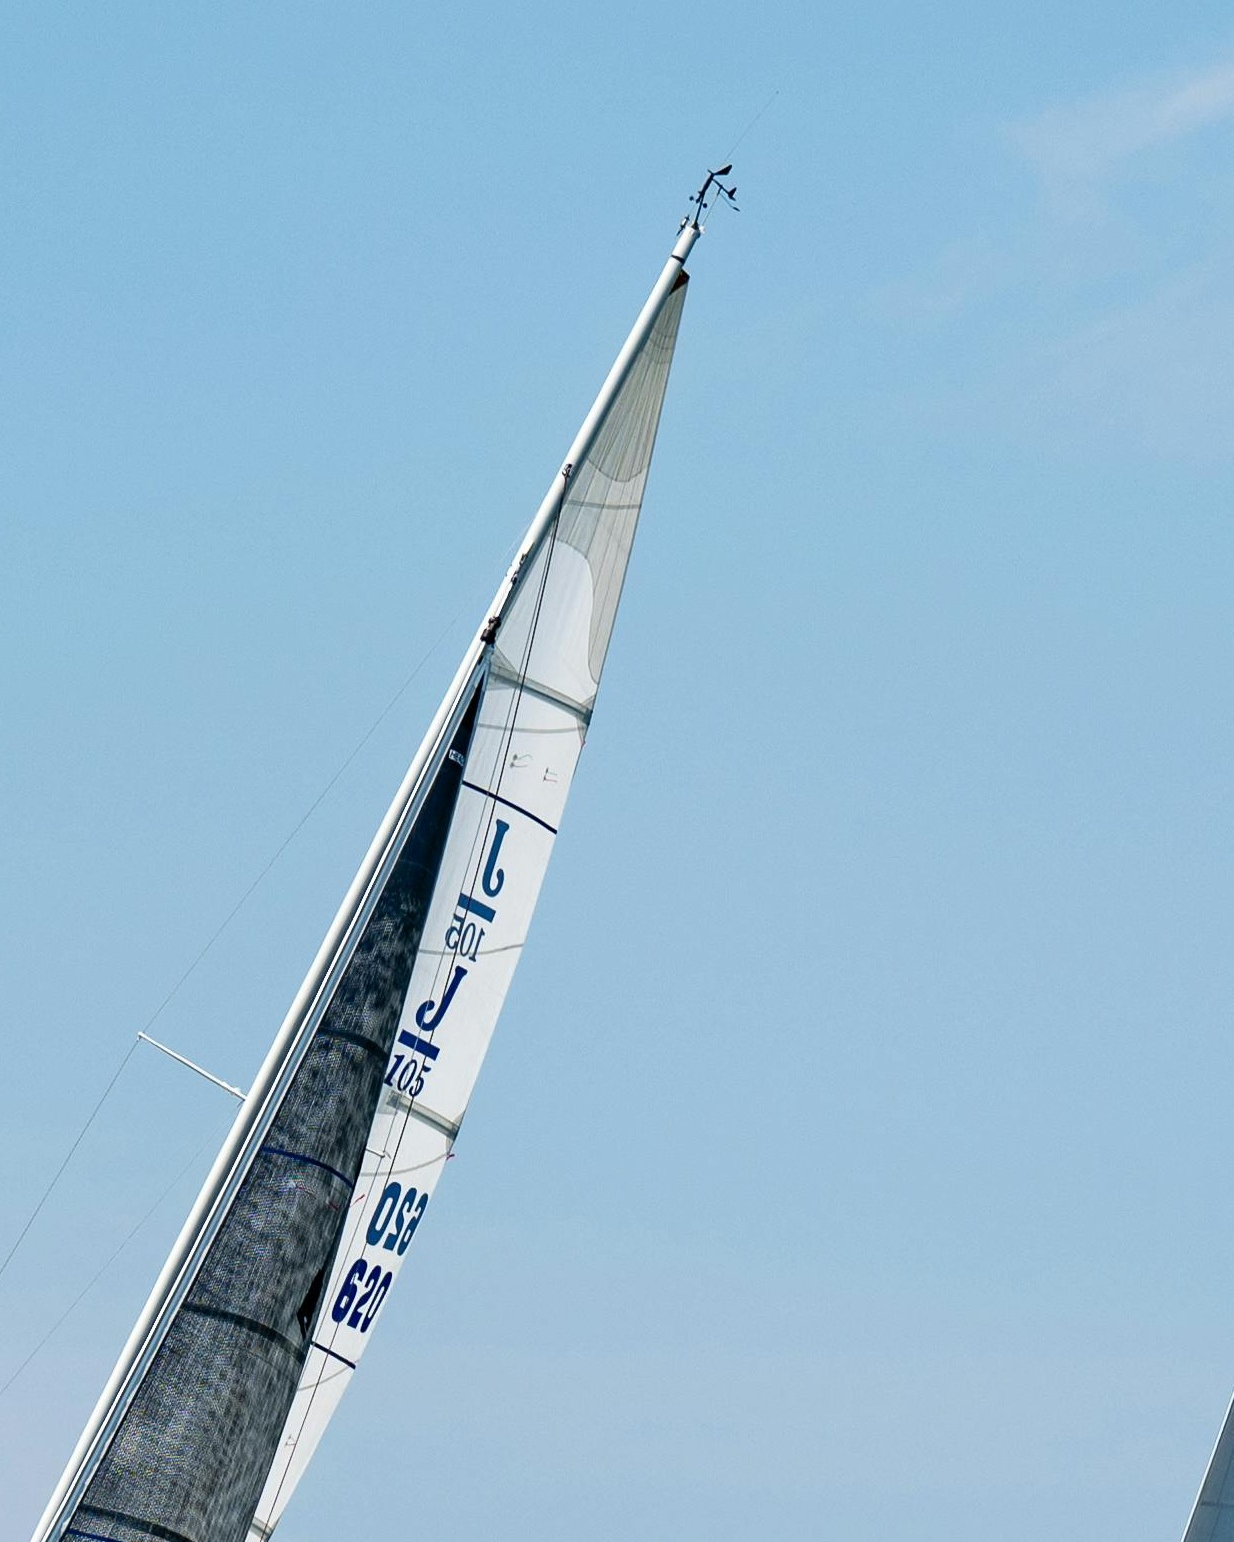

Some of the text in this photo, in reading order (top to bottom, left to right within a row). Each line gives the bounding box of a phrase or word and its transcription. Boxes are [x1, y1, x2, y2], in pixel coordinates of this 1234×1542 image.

[416, 965, 468, 1032] J
[383, 1054, 432, 1098] 105
[331, 1258, 393, 1334] 620
